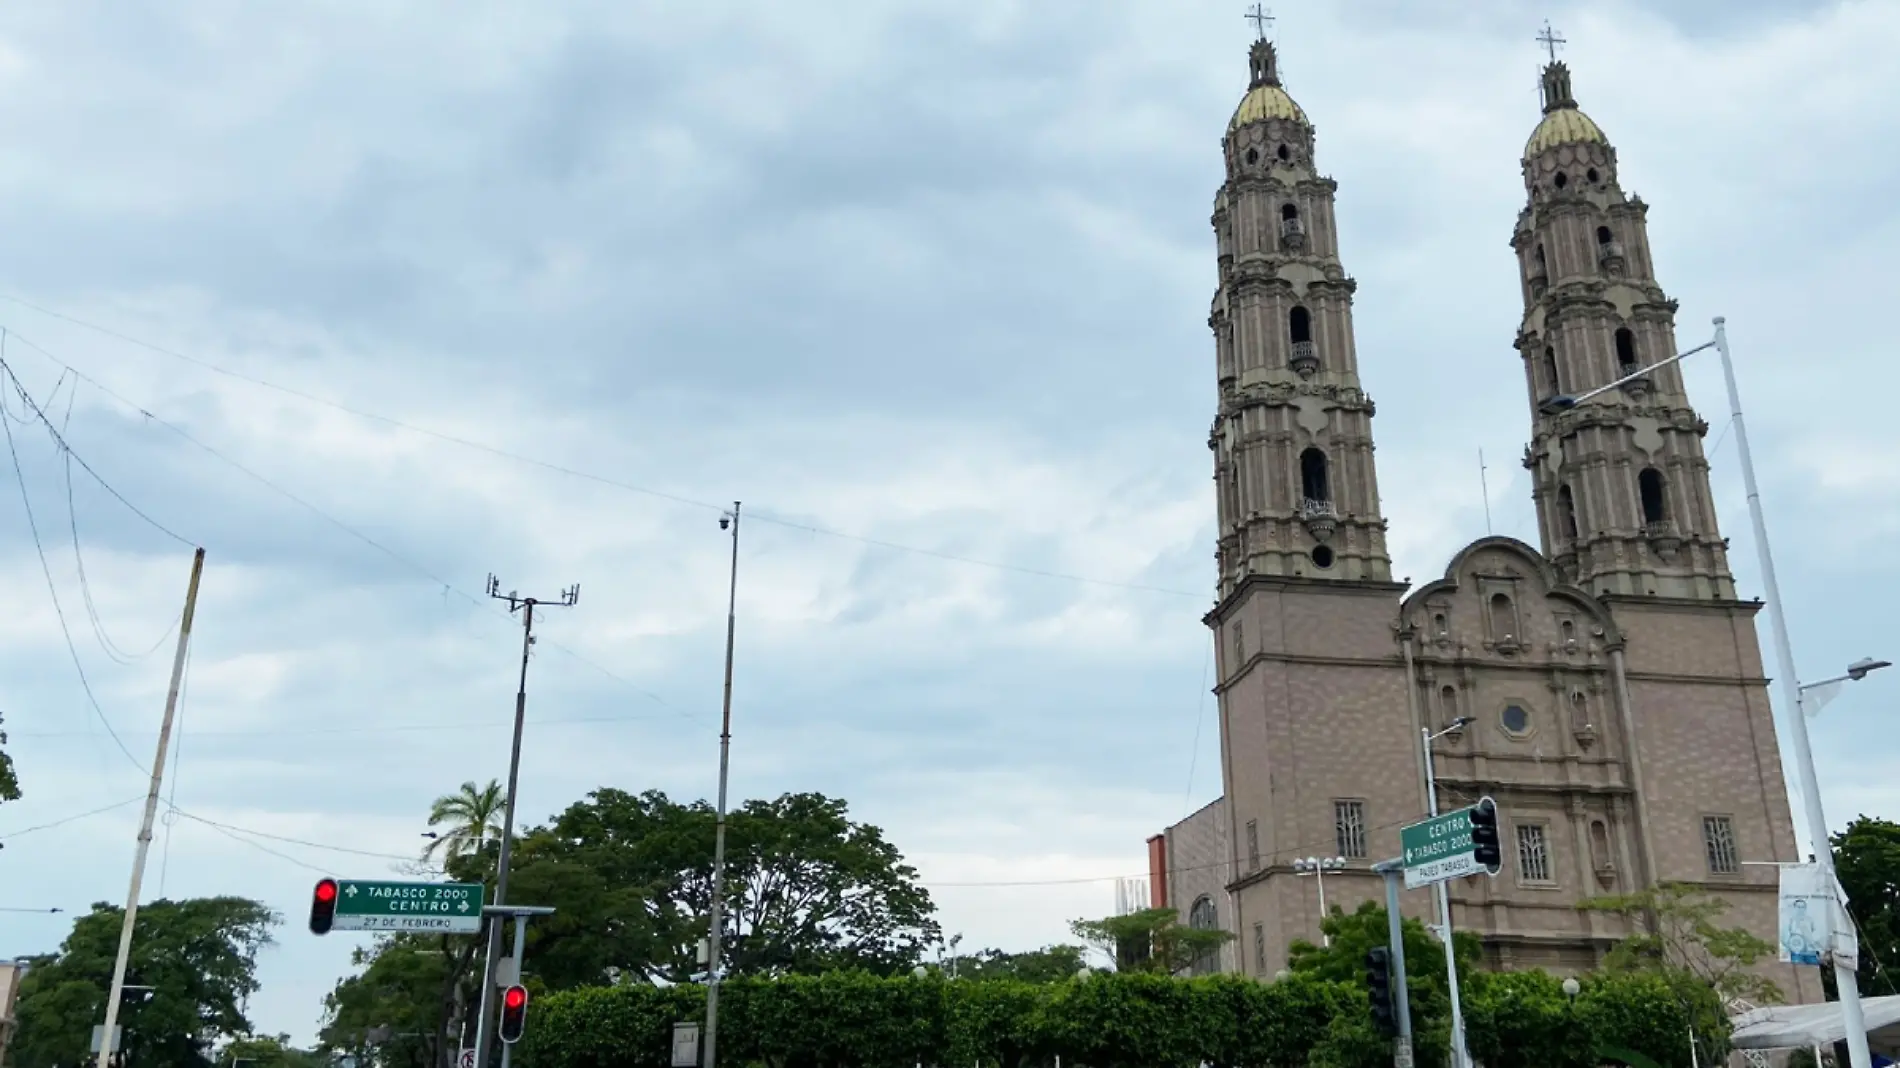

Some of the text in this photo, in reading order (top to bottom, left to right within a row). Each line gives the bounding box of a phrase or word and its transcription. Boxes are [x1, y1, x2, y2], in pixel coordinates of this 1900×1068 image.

[1429, 817, 1465, 838] CENTRO
[1415, 833, 1472, 859] TABASCO 2000
[1441, 858, 1470, 872] TABASCO
[368, 887, 469, 900] TABASCO 2000
[389, 901, 449, 912] CENTRO
[363, 917, 451, 928] 27 DE FEBRERO
